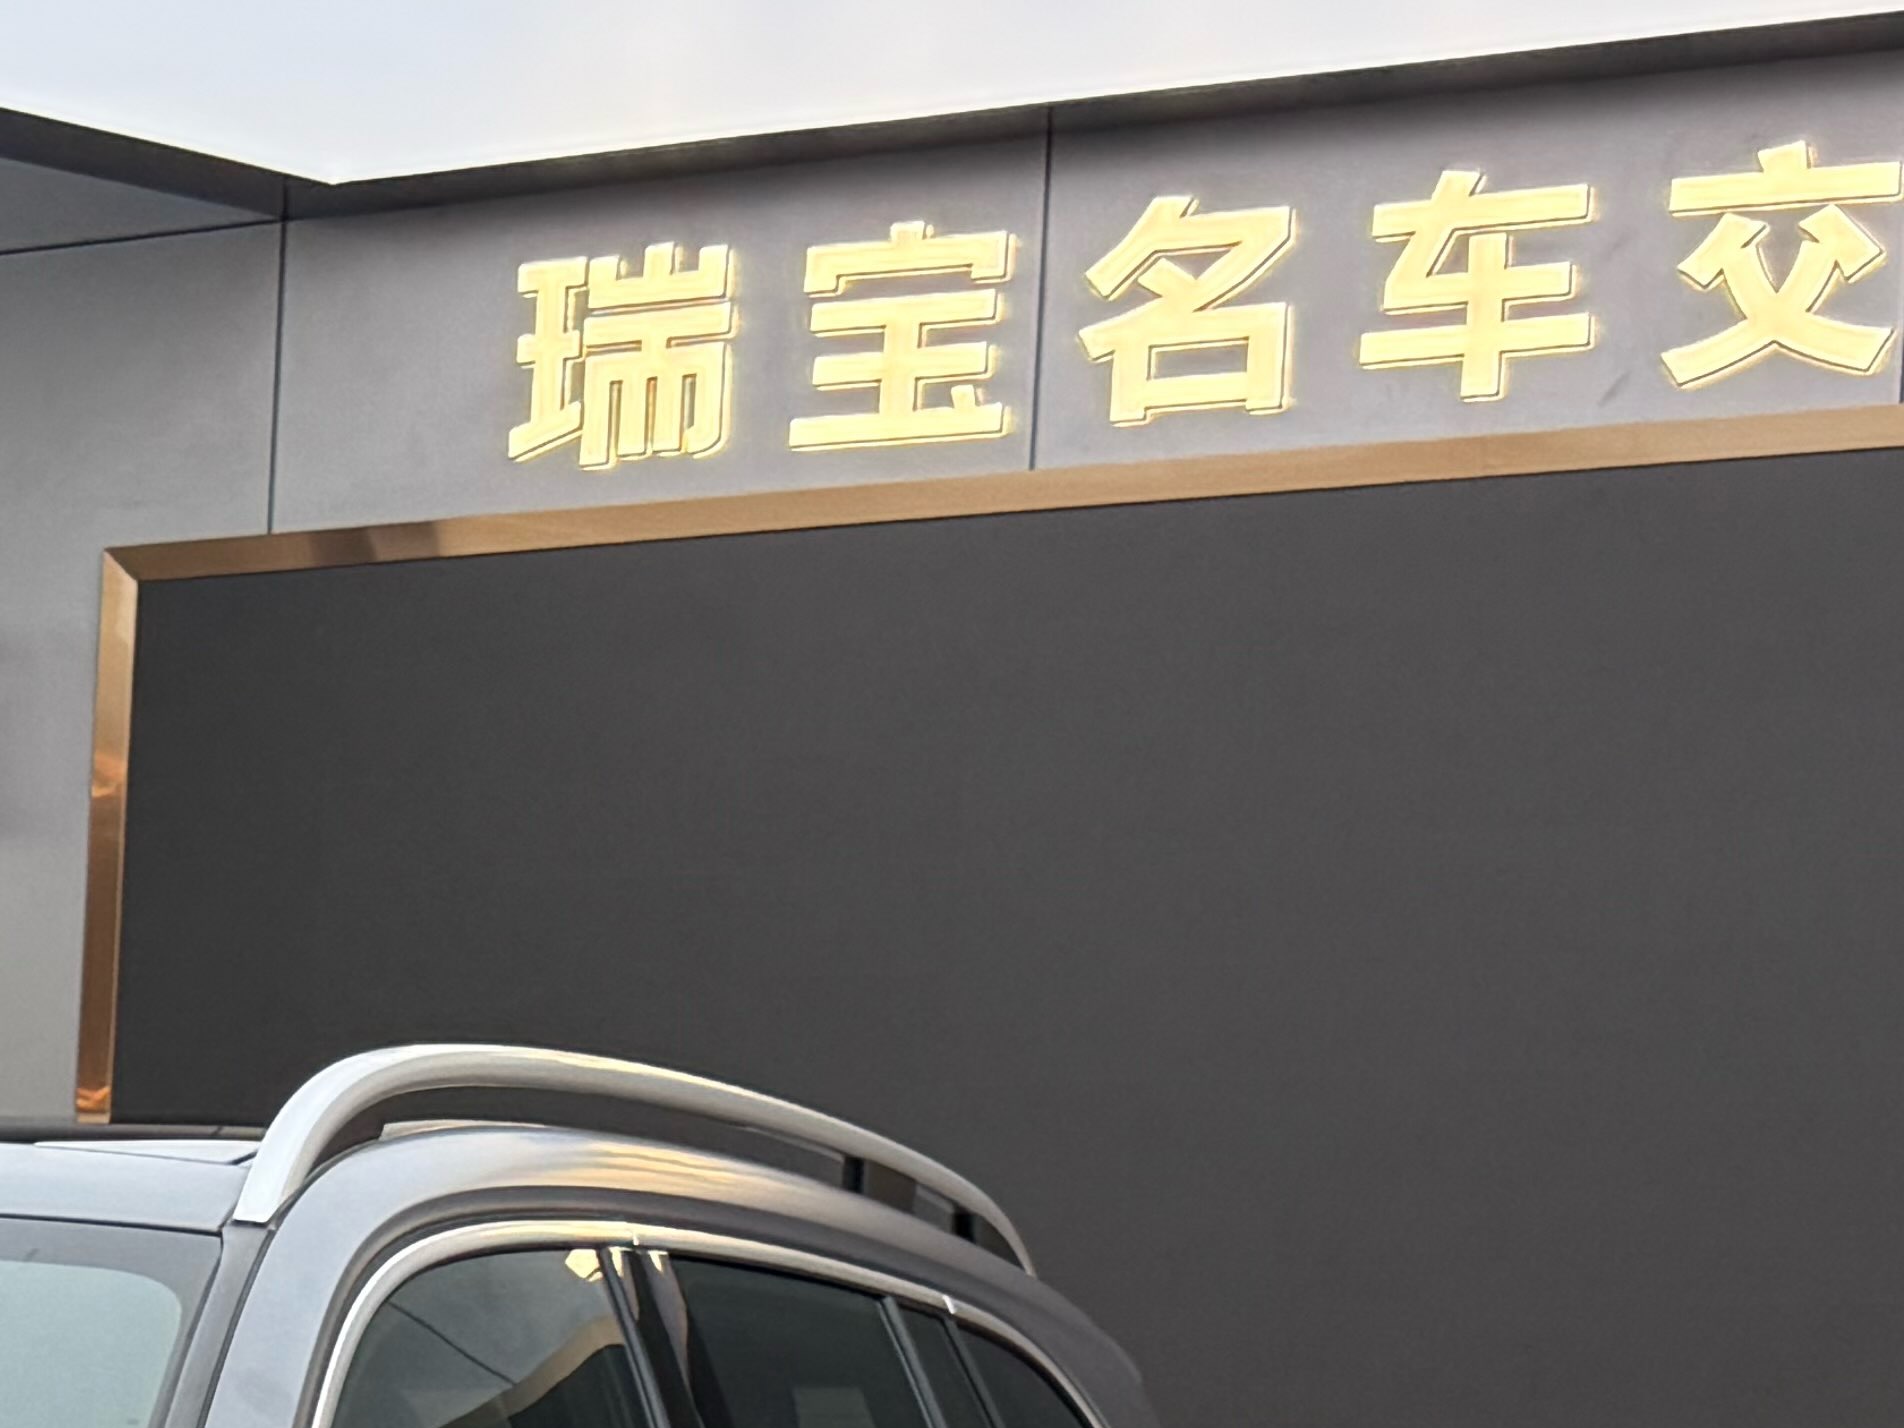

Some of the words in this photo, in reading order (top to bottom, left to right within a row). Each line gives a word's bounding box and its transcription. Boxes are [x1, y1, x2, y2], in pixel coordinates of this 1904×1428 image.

[505, 139, 1903, 471] 瑞宝名车交
